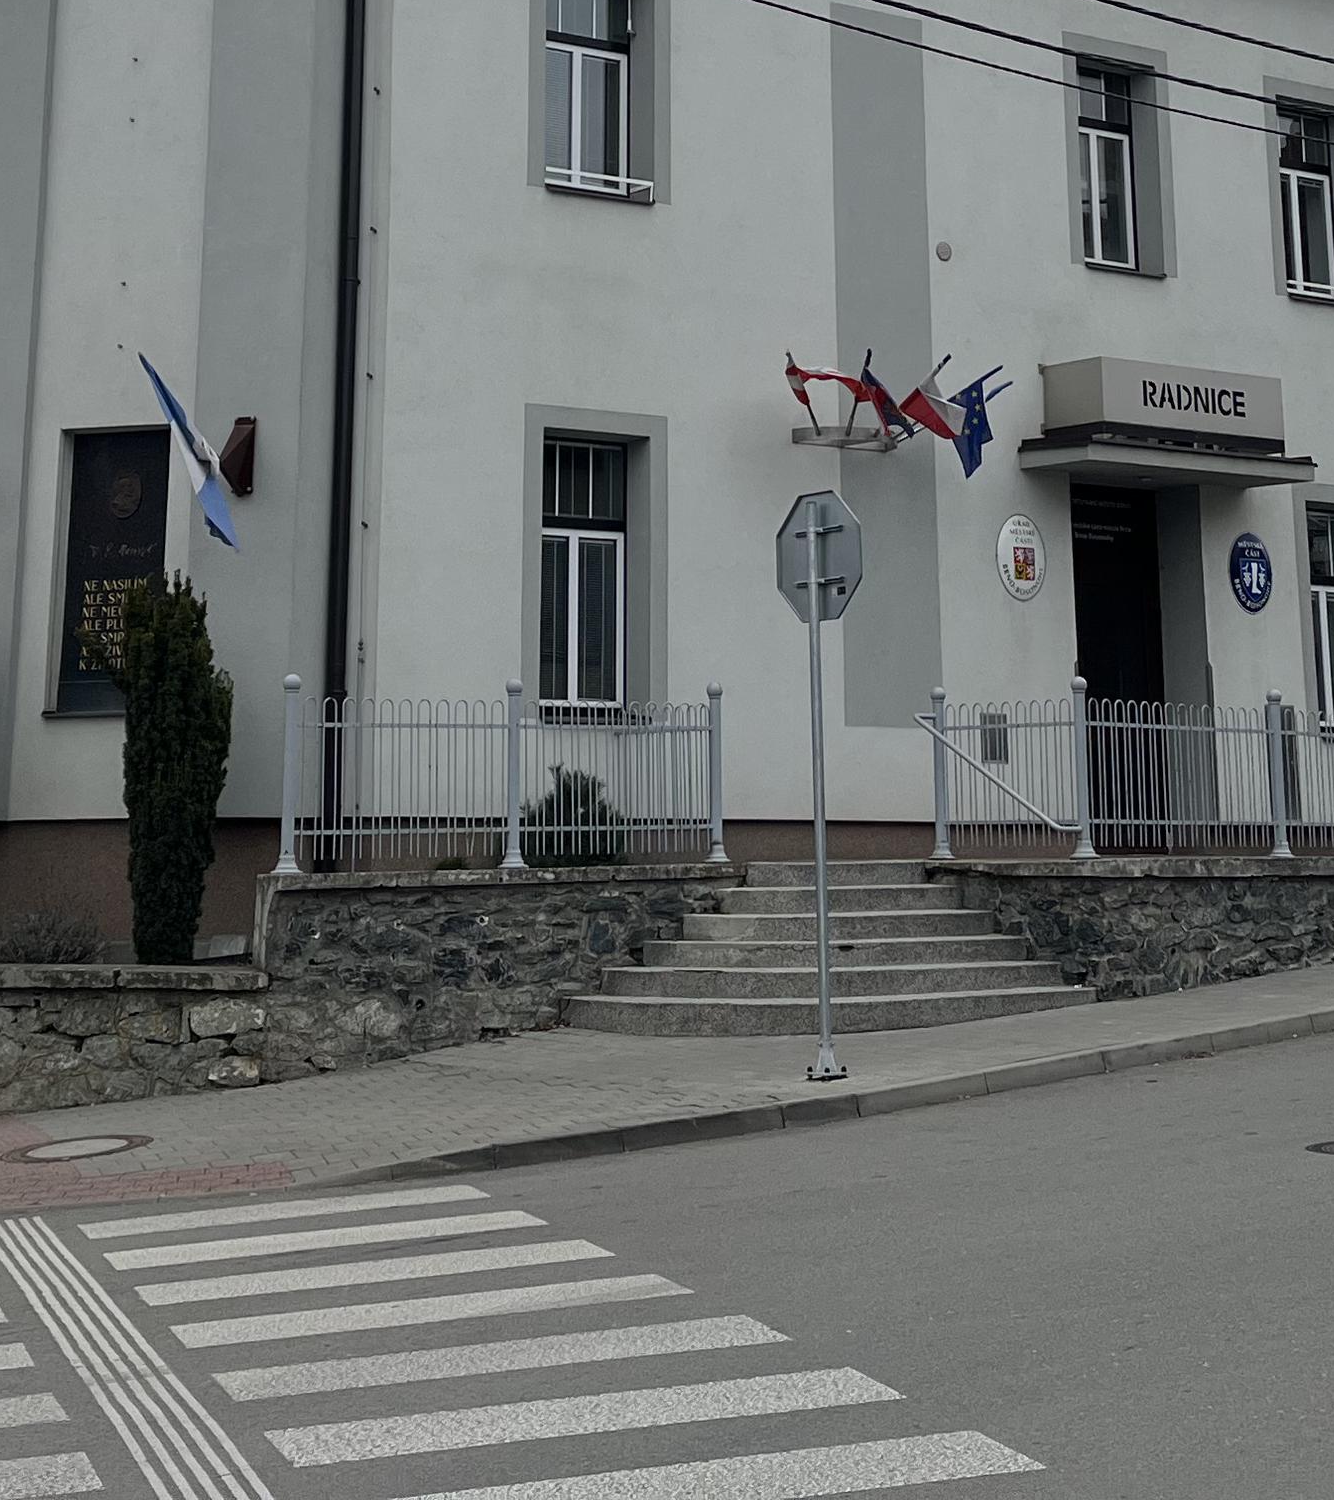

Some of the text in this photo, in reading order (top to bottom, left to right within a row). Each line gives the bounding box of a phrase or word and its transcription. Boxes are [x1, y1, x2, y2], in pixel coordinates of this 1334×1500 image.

[1142, 379, 1246, 418] RADNICE
[83, 579, 99, 592] NE
[82, 606, 98, 618] NE
